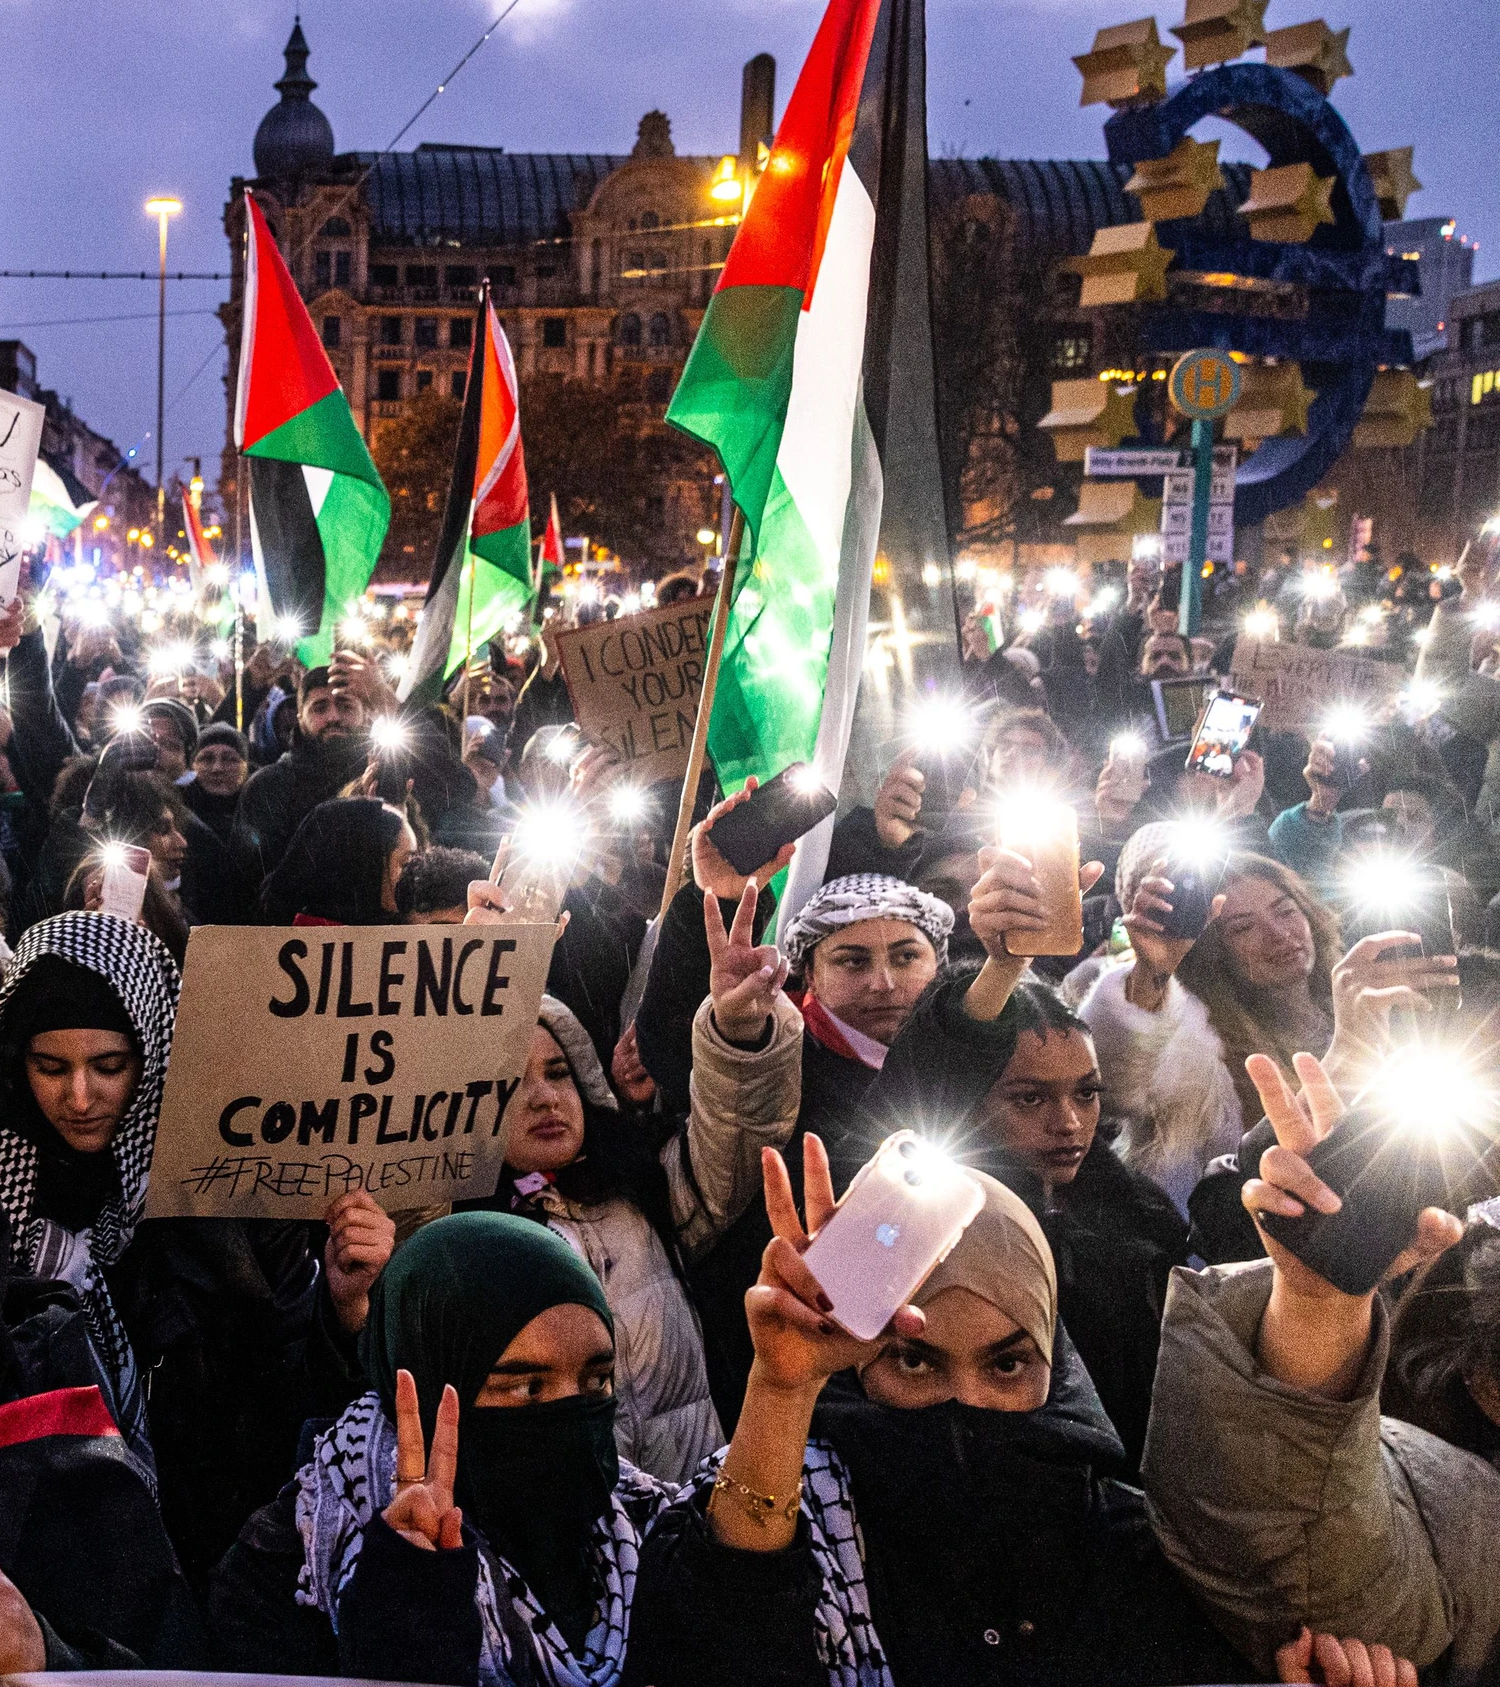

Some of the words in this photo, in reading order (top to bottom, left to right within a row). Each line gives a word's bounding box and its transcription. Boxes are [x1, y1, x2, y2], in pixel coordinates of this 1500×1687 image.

[580, 645, 596, 683] I
[621, 660, 703, 712] YOUR
[269, 937, 517, 1018] SILENCE
[341, 1029, 395, 1086] IS
[218, 1076, 522, 1148] COMPLICITY
[180, 1151, 476, 1198] #FREEPALESTINE
